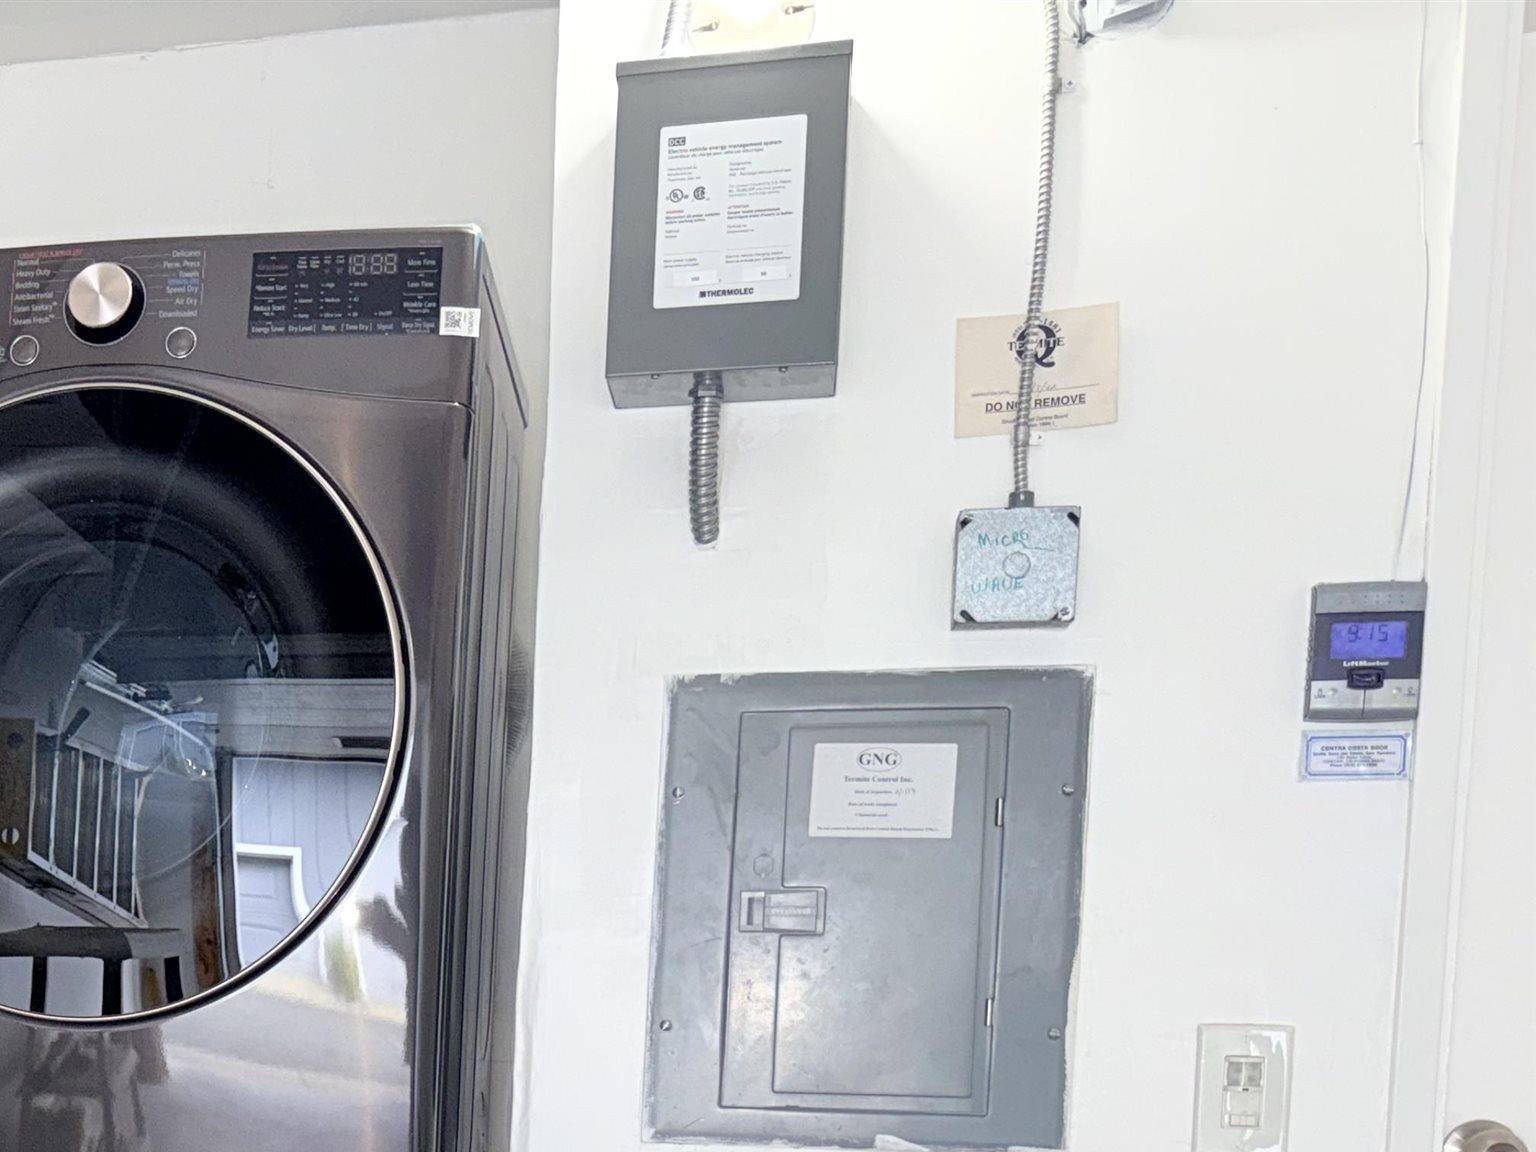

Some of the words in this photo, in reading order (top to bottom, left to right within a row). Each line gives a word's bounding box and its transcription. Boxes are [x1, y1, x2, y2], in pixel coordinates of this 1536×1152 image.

[706, 287, 754, 298] THERMOLEC
[985, 402, 1003, 413] DO
[1033, 393, 1087, 409] REMOVE
[858, 752, 898, 766] GNG
